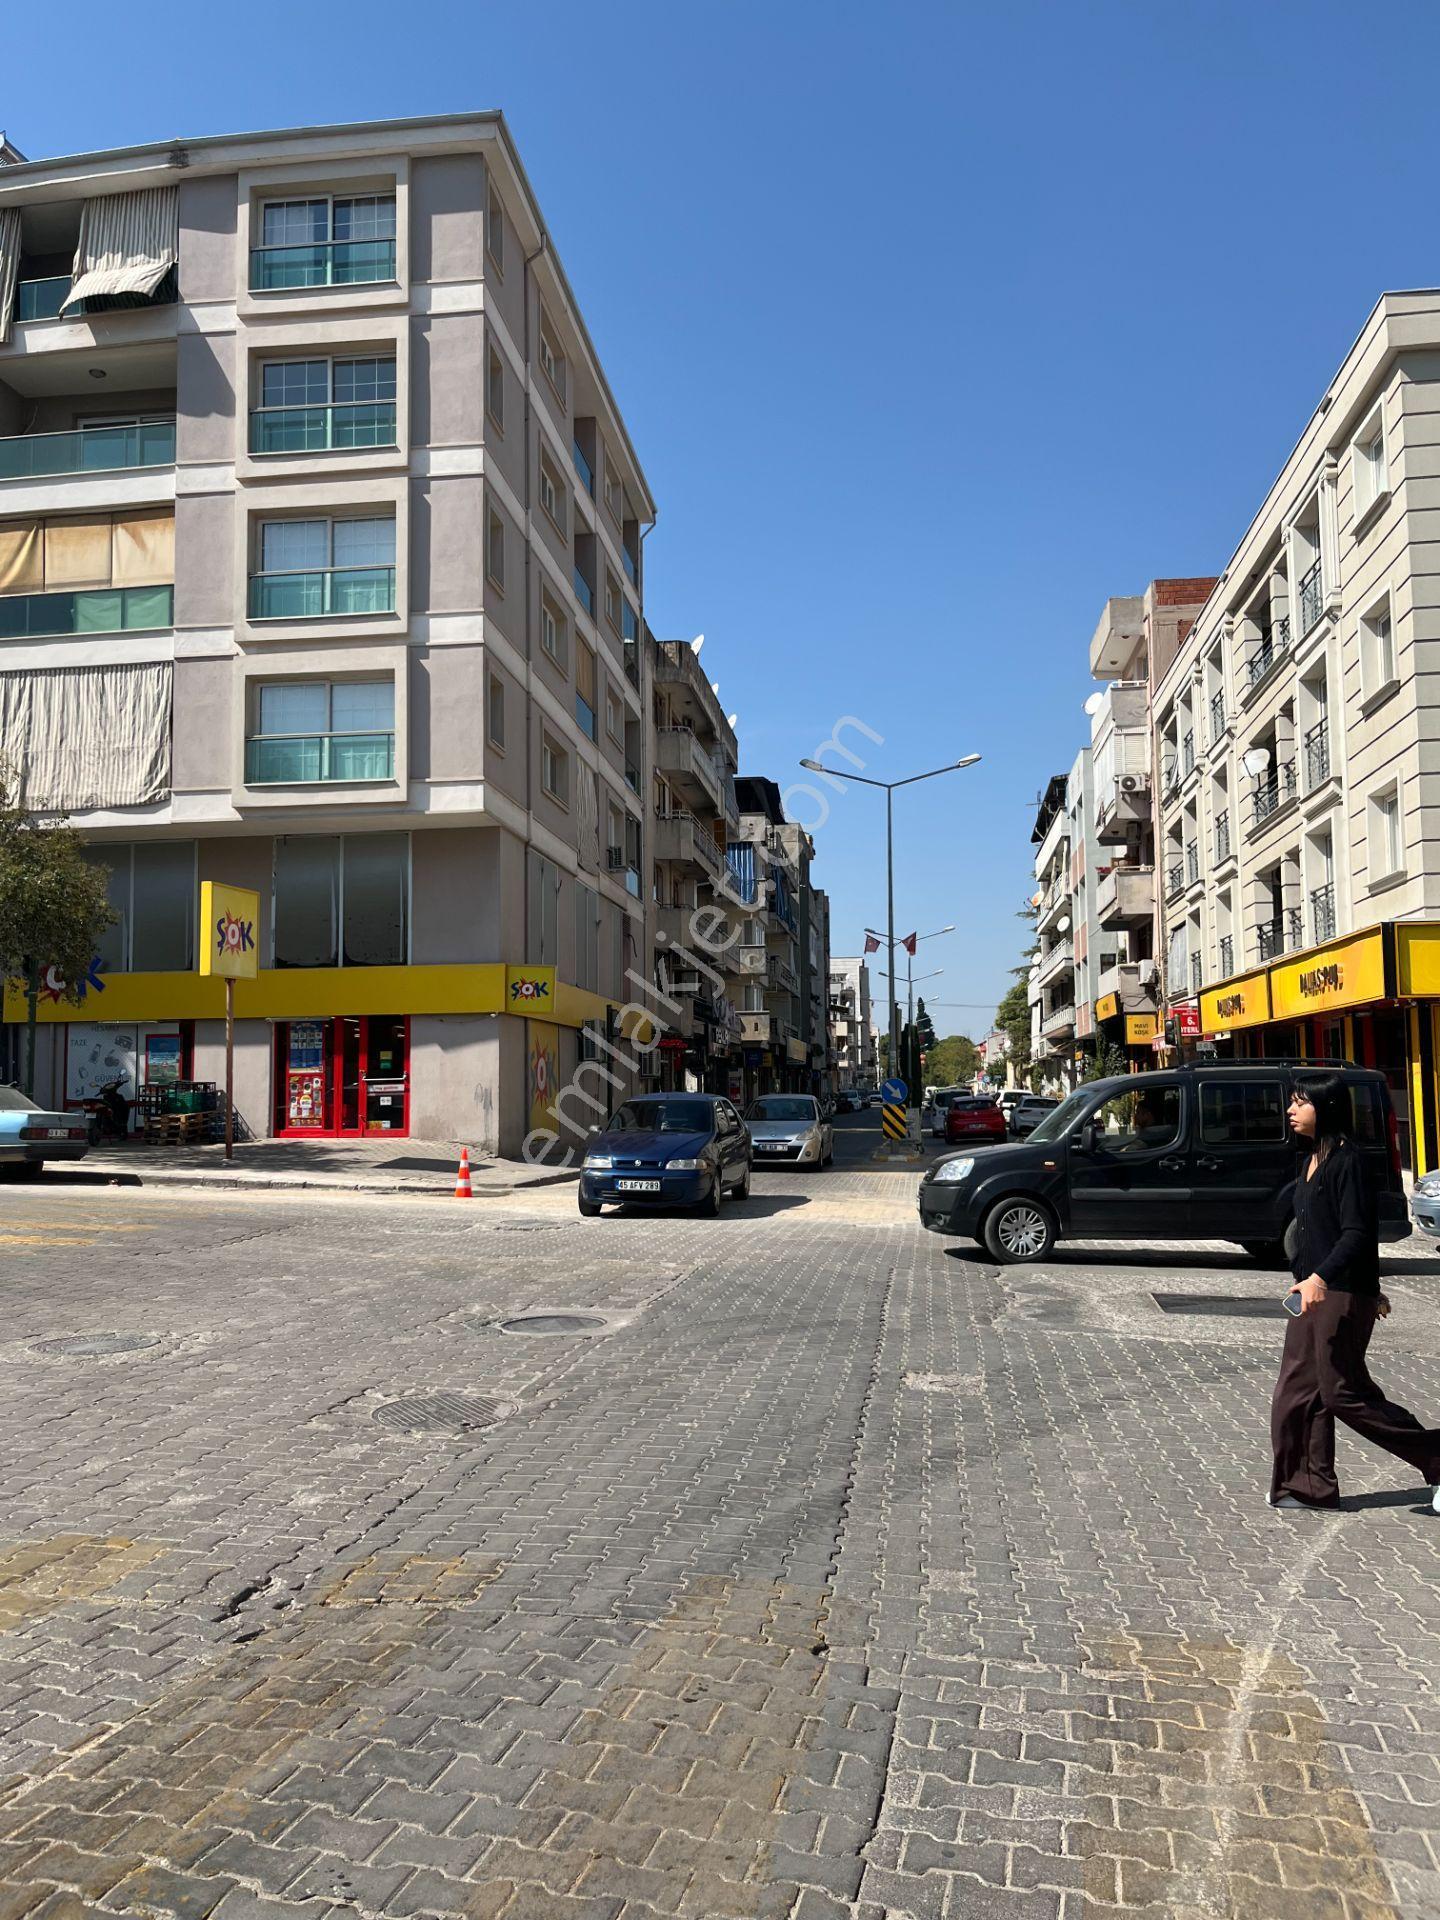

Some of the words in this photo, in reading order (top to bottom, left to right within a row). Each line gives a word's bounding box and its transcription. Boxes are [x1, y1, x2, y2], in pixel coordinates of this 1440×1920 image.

[217, 917, 255, 957] ŞOK
[511, 981, 549, 1001] ŞOK
[620, 1181, 629, 1189] 45
[629, 1181, 644, 1190] AFV
[645, 1181, 660, 1190] 289
